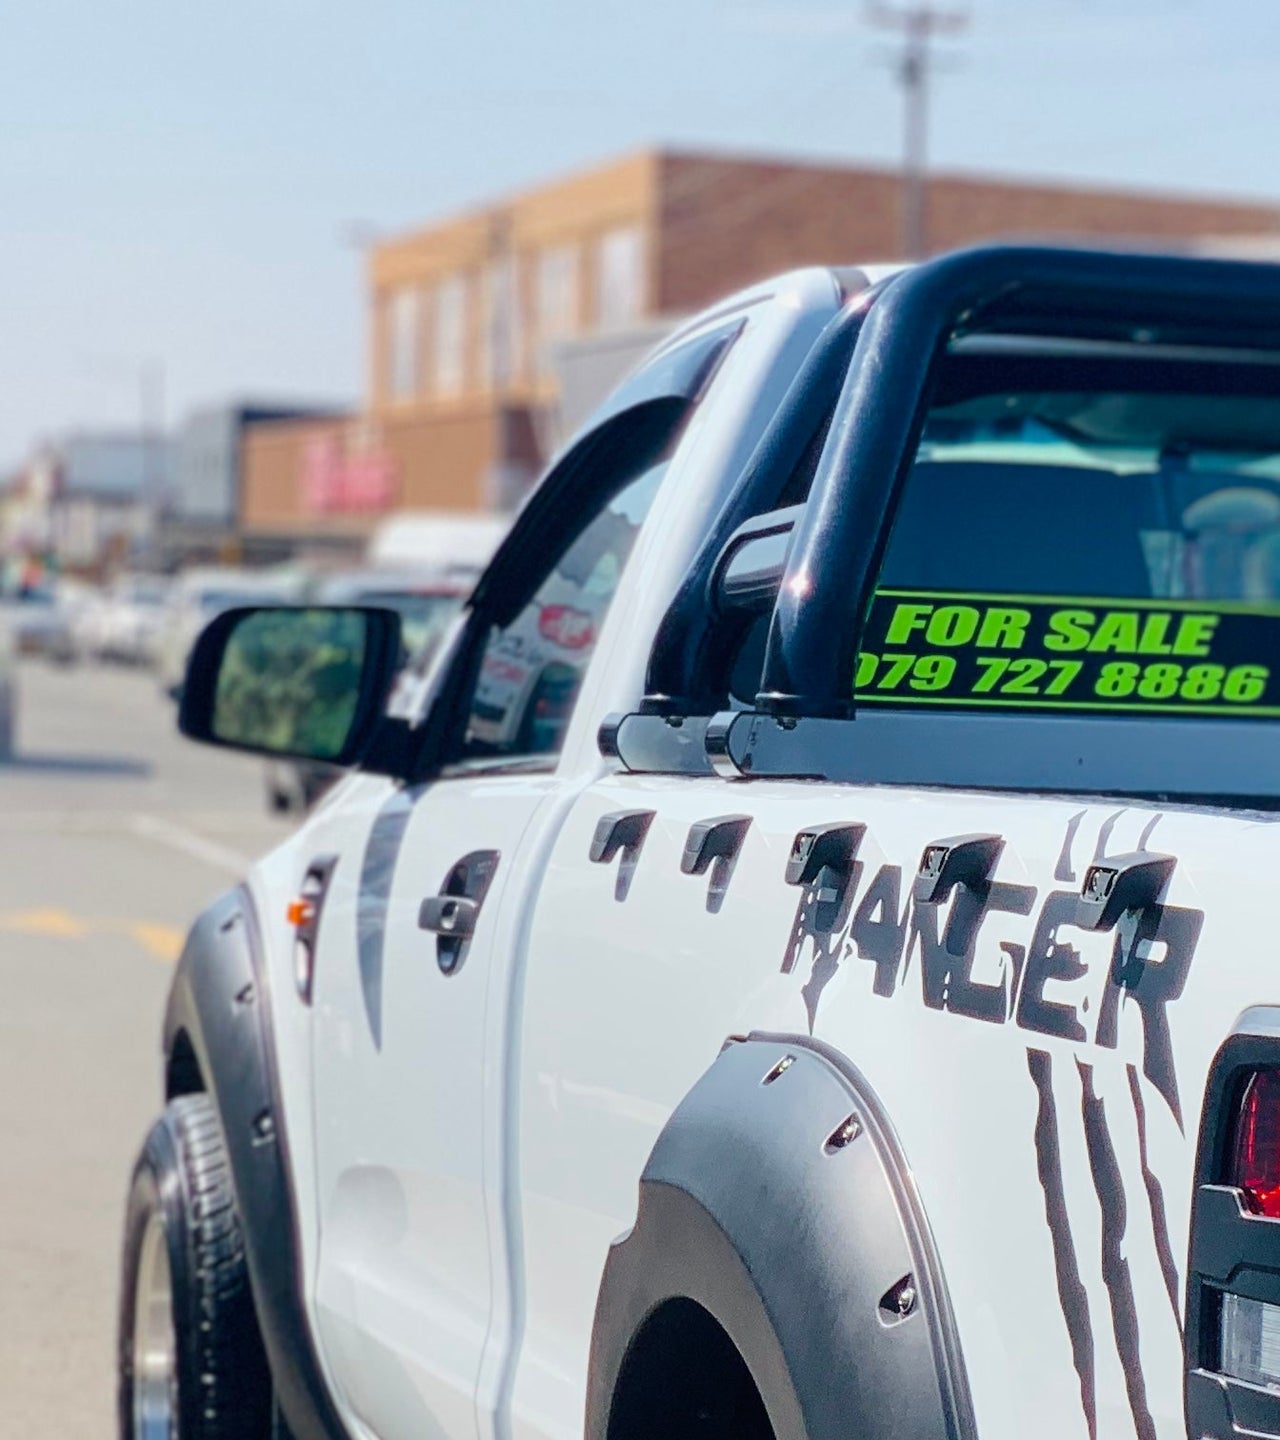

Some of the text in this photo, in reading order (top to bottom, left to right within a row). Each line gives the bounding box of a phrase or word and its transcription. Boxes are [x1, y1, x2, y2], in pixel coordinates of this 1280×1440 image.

[885, 604, 1219, 656] FOR SALE
[972, 657, 1084, 695] 727
[1094, 662, 1269, 702] 8886
[778, 856, 1206, 1140] RANGER
